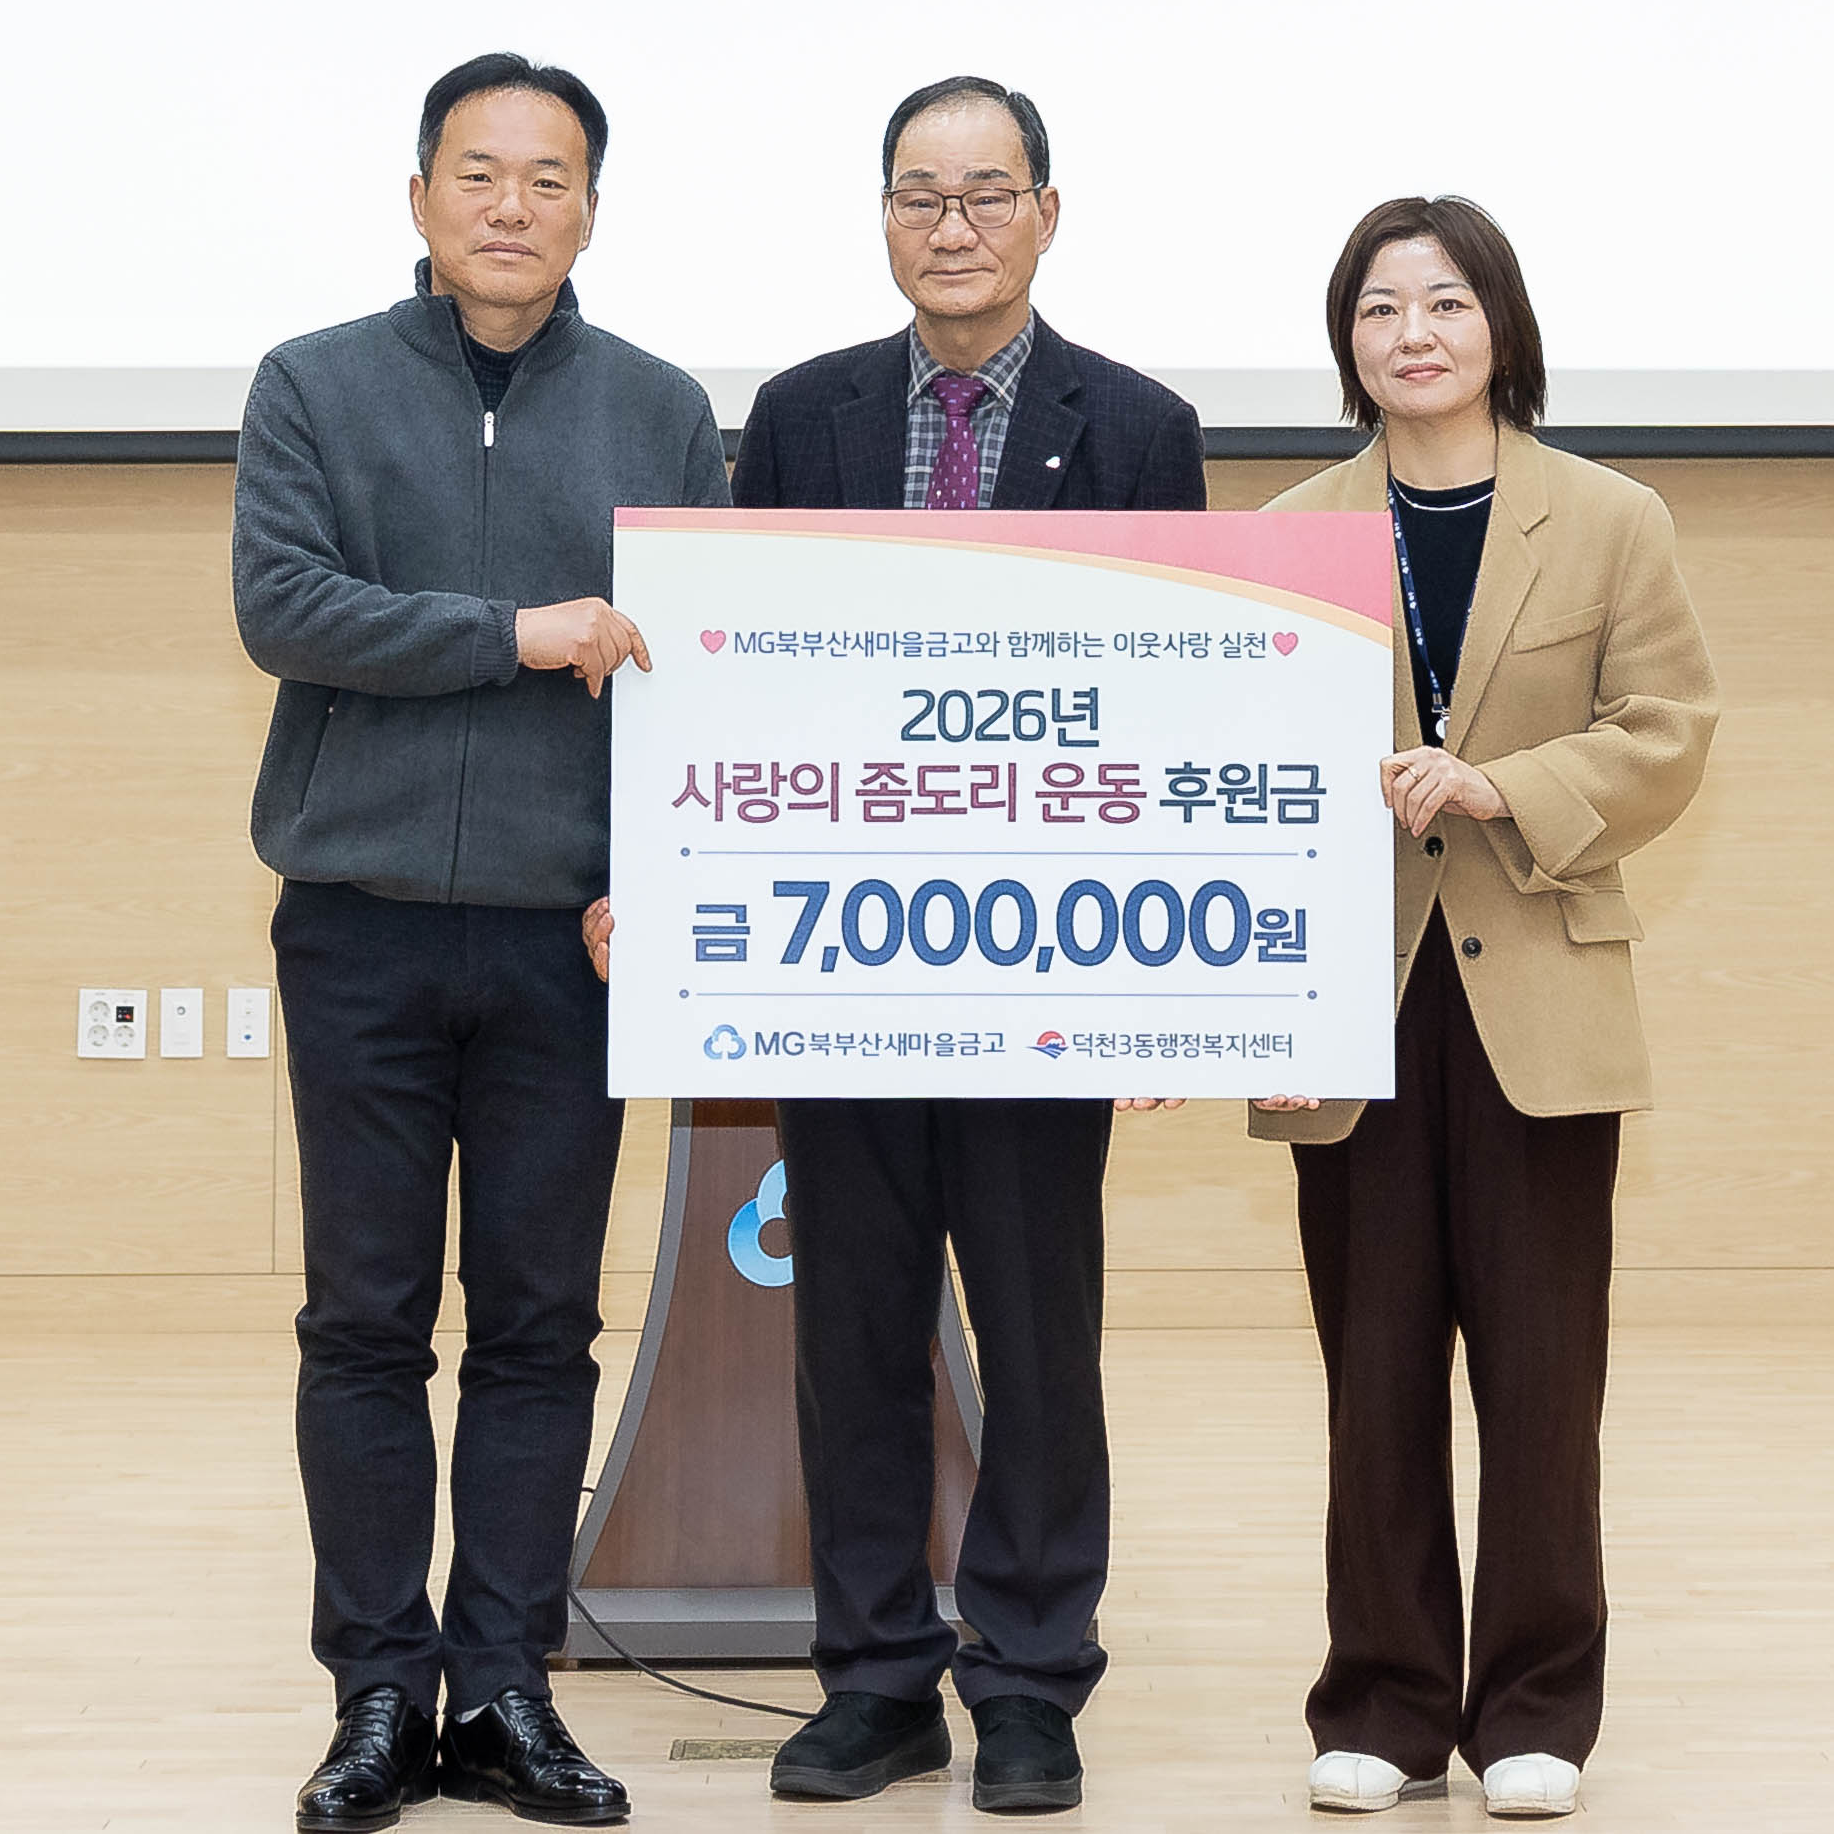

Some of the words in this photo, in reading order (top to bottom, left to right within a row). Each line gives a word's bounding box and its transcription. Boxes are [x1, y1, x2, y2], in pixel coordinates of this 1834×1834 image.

[735, 631, 1000, 657] MG북부산새마을금고와
[1007, 632, 1105, 658] 함께하는
[1114, 632, 1212, 658] 이웃사랑
[1219, 632, 1265, 658] 실천
[901, 687, 1099, 747] 2026년
[672, 762, 839, 823] 사랑의
[855, 763, 1016, 822] 좀도리
[1035, 763, 1147, 824] 운동
[1159, 761, 1327, 824] 후원금
[693, 904, 750, 962] 금
[755, 1032, 1006, 1056] MG북부산새마을금고
[1073, 1033, 1292, 1058] 덕천3동행정복지센터
